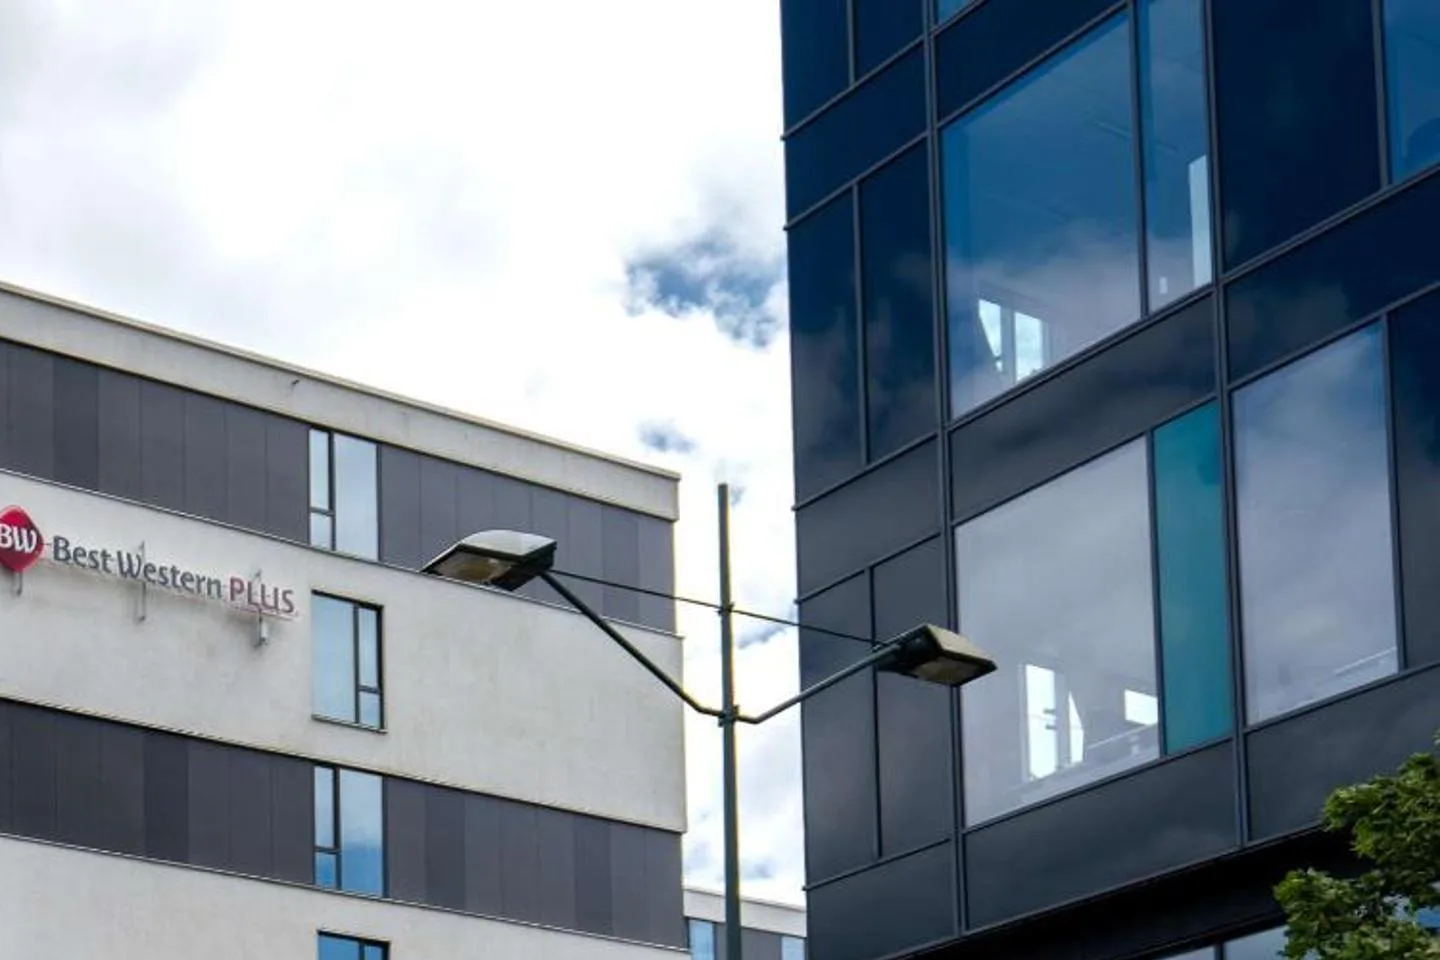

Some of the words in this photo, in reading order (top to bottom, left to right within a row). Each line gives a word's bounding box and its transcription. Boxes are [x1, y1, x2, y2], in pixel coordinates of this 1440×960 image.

[52, 535, 112, 573] Best
[115, 549, 222, 598] Western
[228, 576, 295, 614] PLUS
